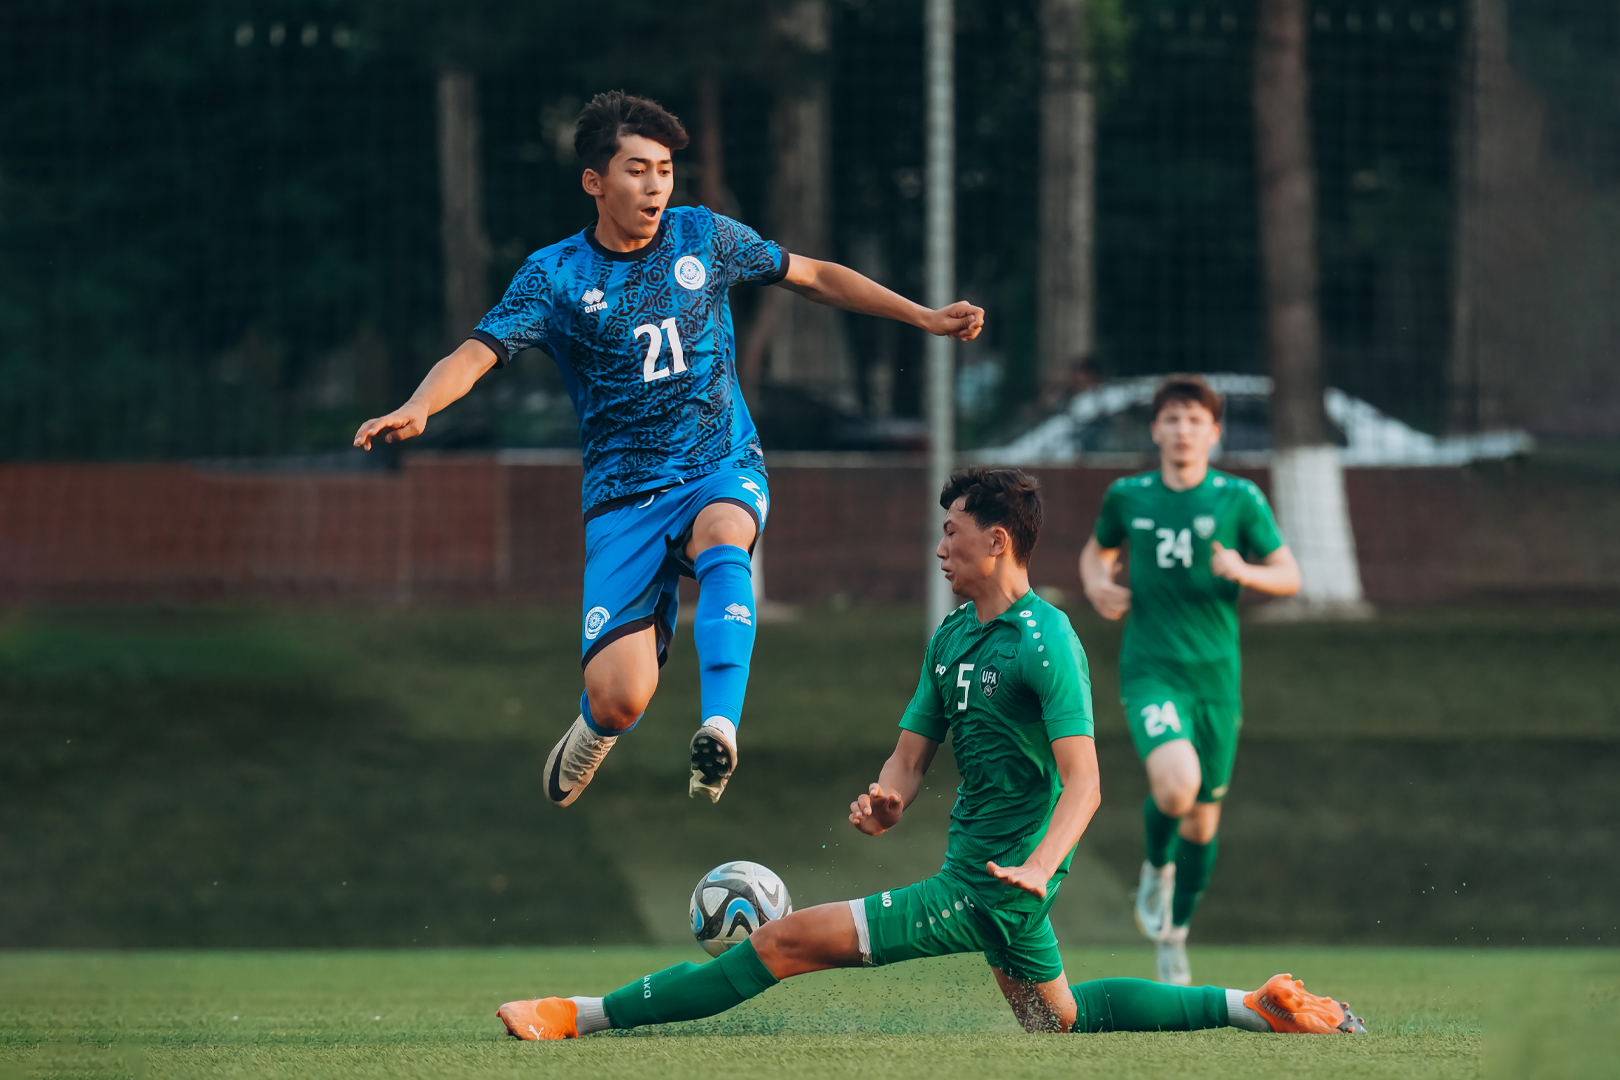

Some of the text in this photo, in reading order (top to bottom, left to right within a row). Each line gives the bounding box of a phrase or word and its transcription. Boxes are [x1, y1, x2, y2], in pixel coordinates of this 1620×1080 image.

[633, 317, 688, 383] 21
[1155, 528, 1194, 569] 24
[957, 663, 975, 710] 5
[981, 670, 997, 685] UFA
[1140, 701, 1183, 738] 24
